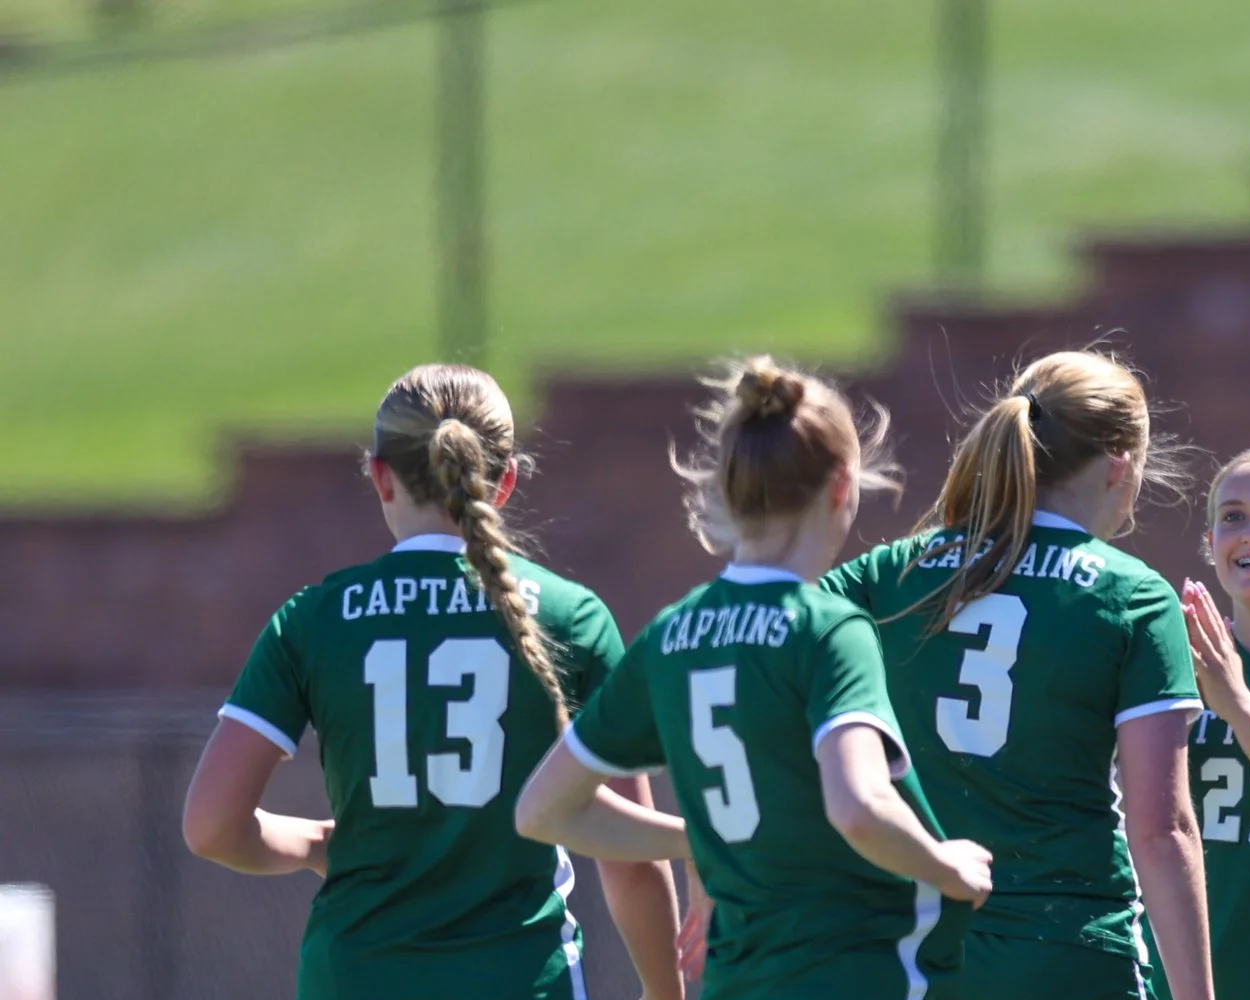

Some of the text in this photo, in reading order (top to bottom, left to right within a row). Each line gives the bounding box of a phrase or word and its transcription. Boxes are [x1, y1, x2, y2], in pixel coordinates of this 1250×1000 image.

[342, 576, 541, 621] CAPTAIS
[917, 534, 1106, 588] CAPAINS
[661, 601, 797, 656] CAPTAINS
[935, 592, 1029, 758] 3
[364, 637, 511, 808] 13
[689, 664, 761, 844] 5
